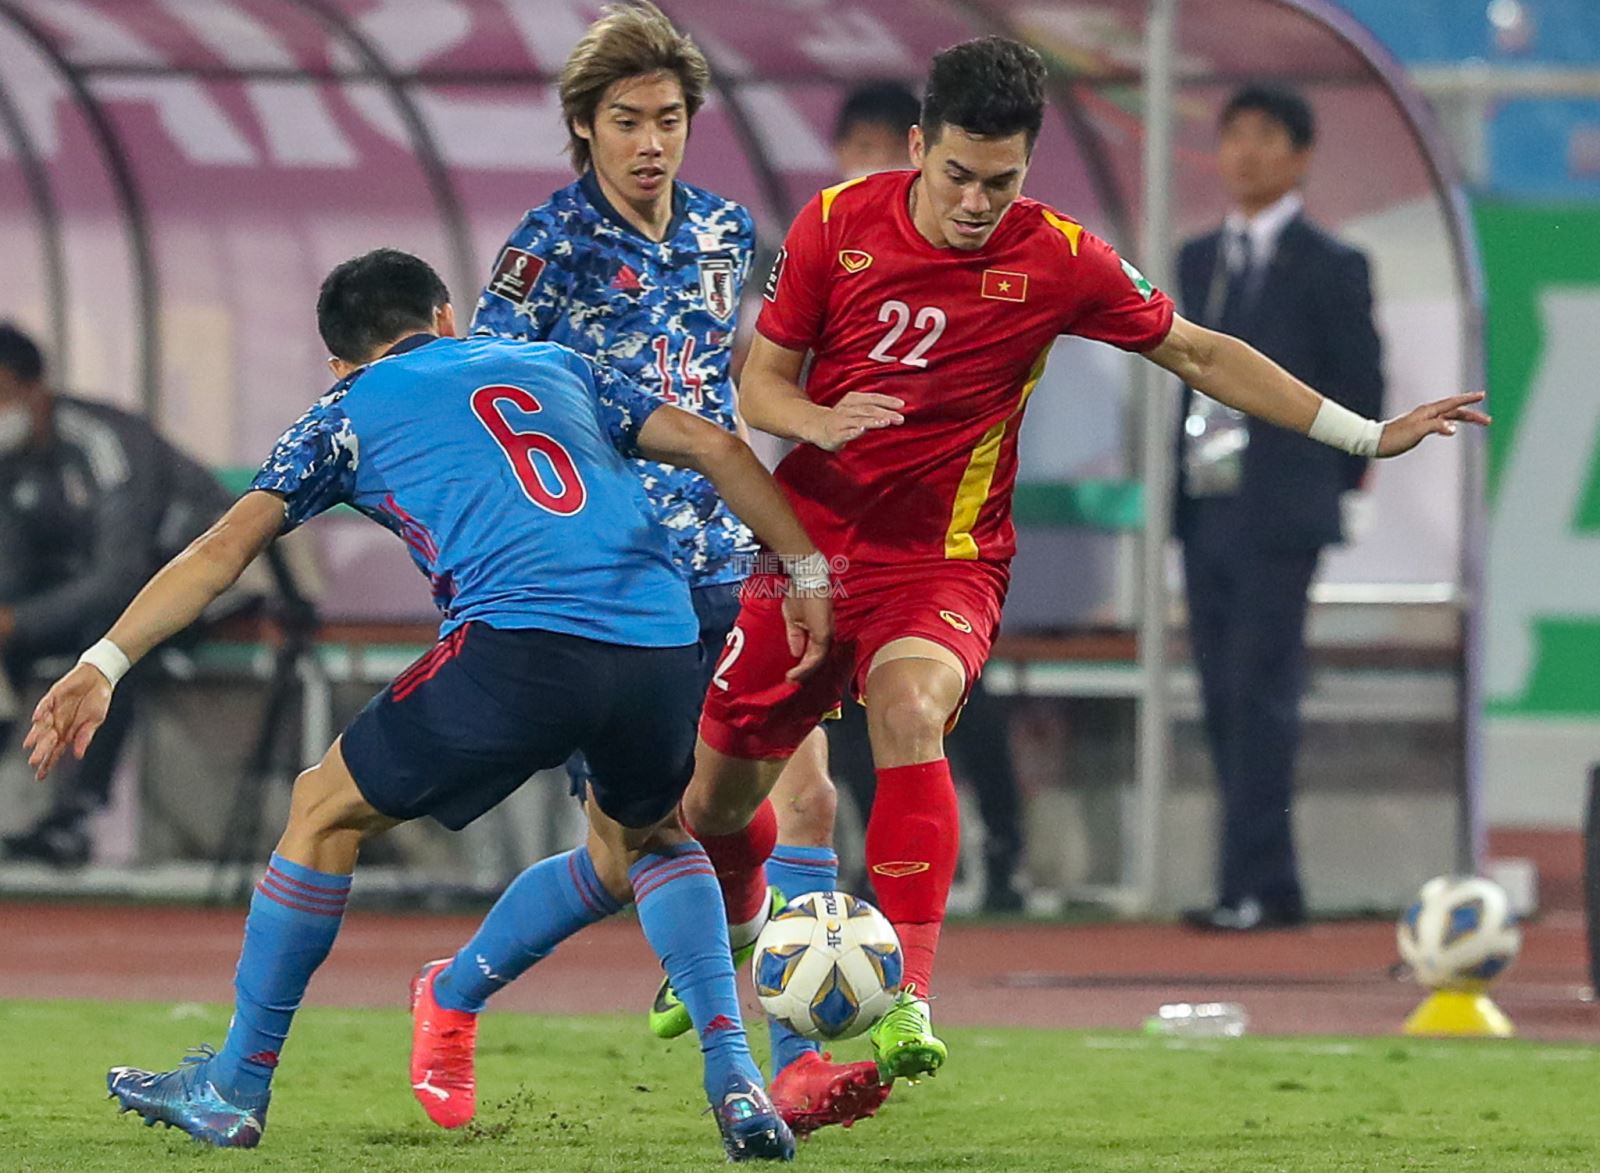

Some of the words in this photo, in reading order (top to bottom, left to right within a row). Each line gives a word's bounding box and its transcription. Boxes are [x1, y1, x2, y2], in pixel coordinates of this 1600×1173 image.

[868, 300, 947, 368] 22
[652, 334, 703, 404] 14
[470, 384, 587, 516] 6
[713, 626, 744, 691] 2
